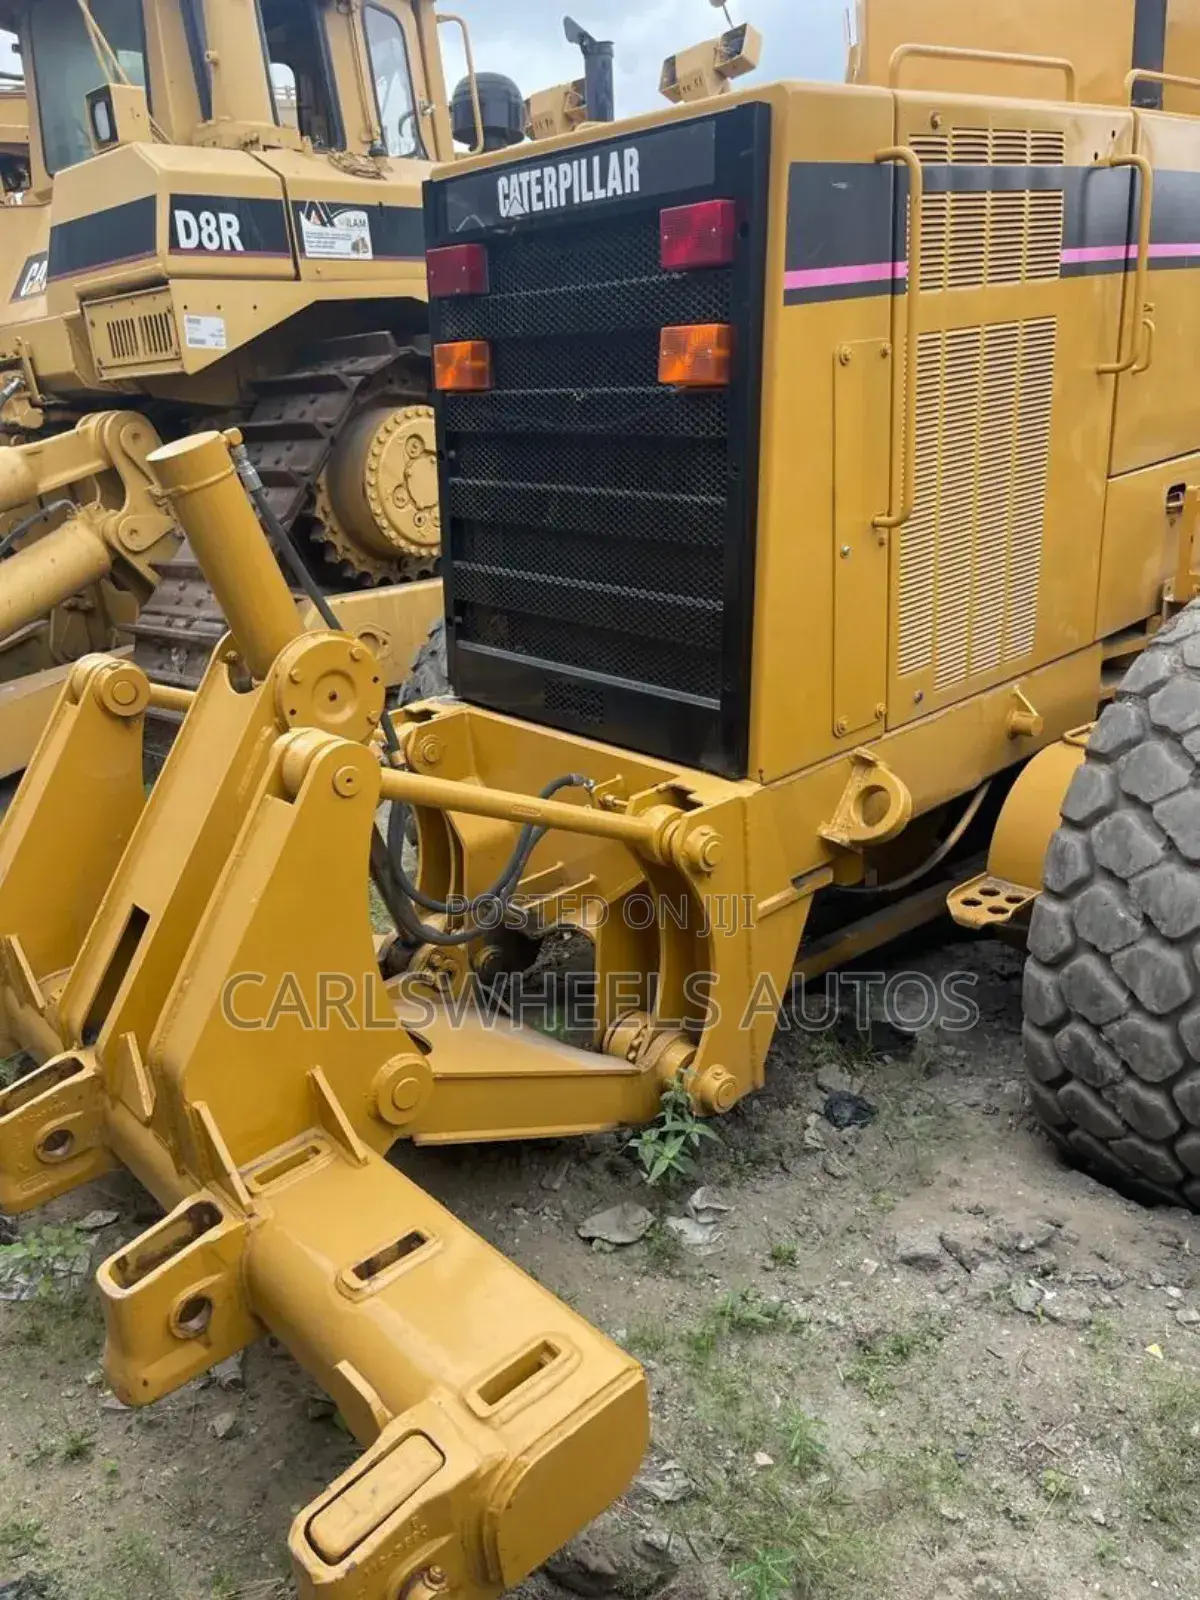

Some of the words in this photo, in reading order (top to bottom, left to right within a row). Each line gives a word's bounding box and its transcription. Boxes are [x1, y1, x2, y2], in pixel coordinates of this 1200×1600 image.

[497, 147, 640, 219] CATERPILLAR
[174, 209, 245, 251] D8R
[20, 260, 48, 297] CA
